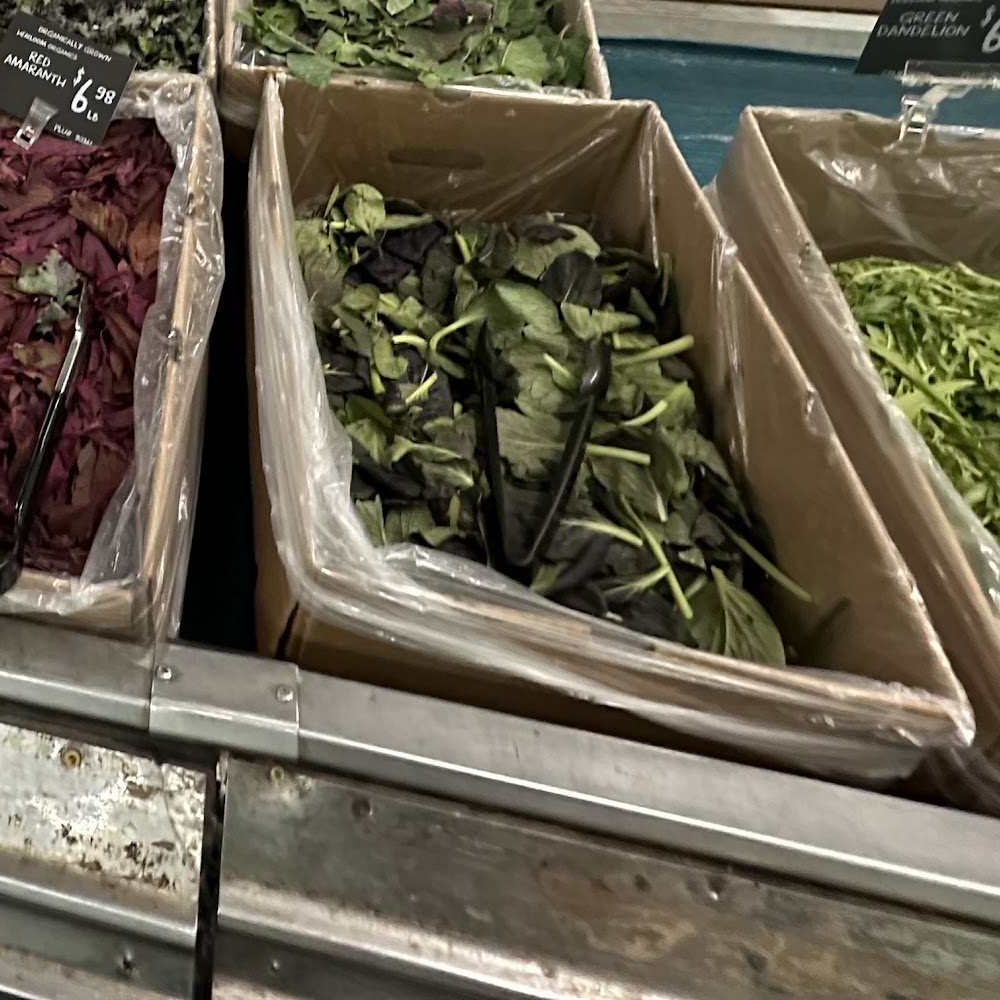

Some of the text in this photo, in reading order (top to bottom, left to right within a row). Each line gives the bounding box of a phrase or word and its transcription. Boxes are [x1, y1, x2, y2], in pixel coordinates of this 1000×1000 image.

[899, 10, 960, 24] GREEN
[16, 29, 47, 47] HEIRLOOM
[877, 24, 973, 38] DANDELION
[38, 25, 112, 63] ORGANICALLY GROWN
[28, 51, 51, 68] RED
[4, 53, 67, 88] AMARANTH
